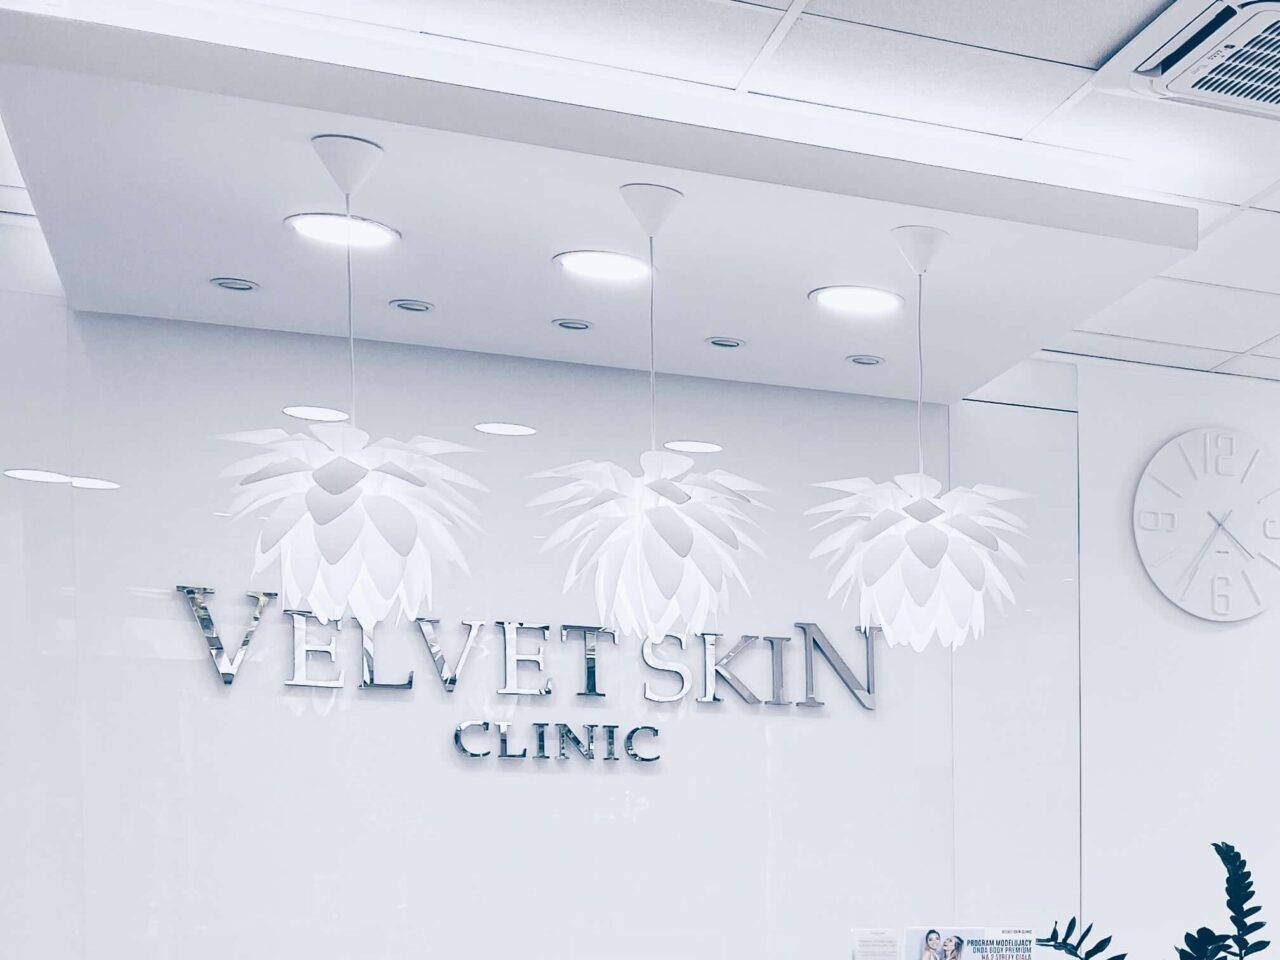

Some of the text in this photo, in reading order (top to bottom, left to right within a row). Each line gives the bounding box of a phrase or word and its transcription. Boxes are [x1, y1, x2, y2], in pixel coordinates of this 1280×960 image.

[1203, 432, 1235, 477] 12
[176, 585, 882, 711] VELVET SKIN
[453, 720, 662, 763] CLINIC
[967, 939, 995, 947] PROGRAM
